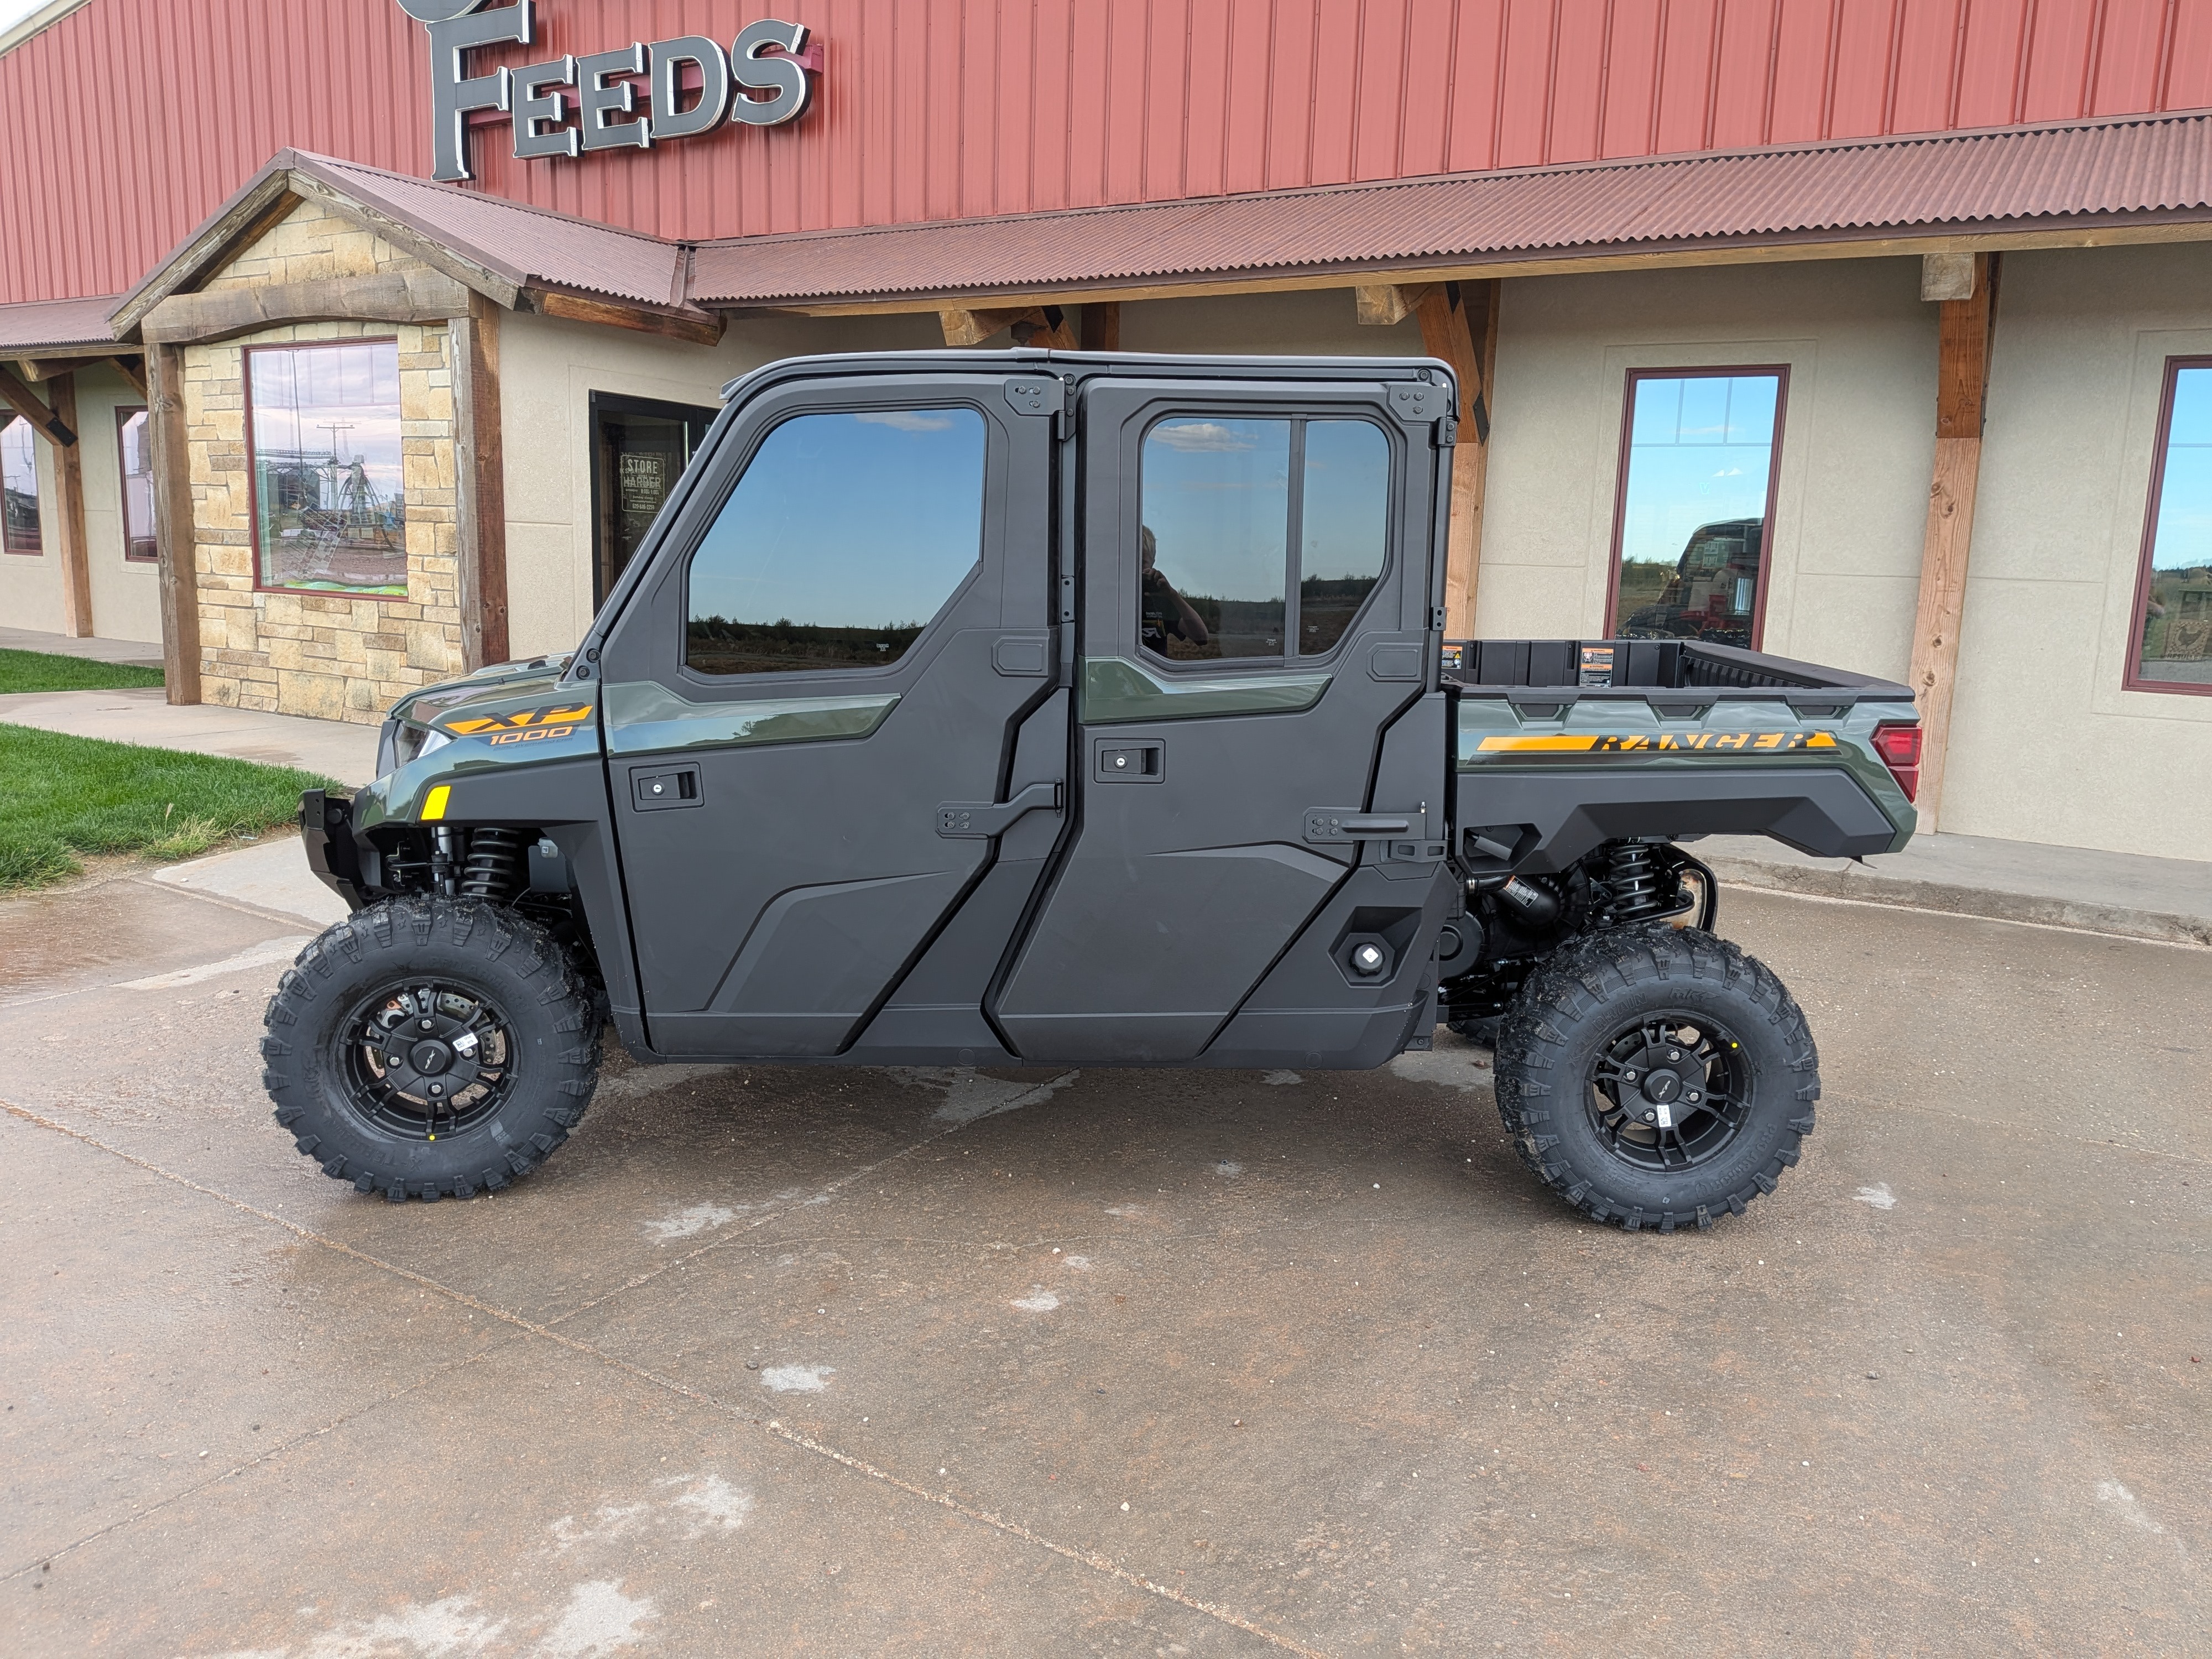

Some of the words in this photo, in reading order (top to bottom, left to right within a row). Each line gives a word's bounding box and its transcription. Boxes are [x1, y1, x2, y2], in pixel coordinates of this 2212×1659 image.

[425, 0, 813, 182] FEEDS
[628, 459, 658, 474] STORE
[466, 702, 588, 733] XP
[490, 726, 573, 746] 1000
[1587, 732, 1817, 752] RANGER
